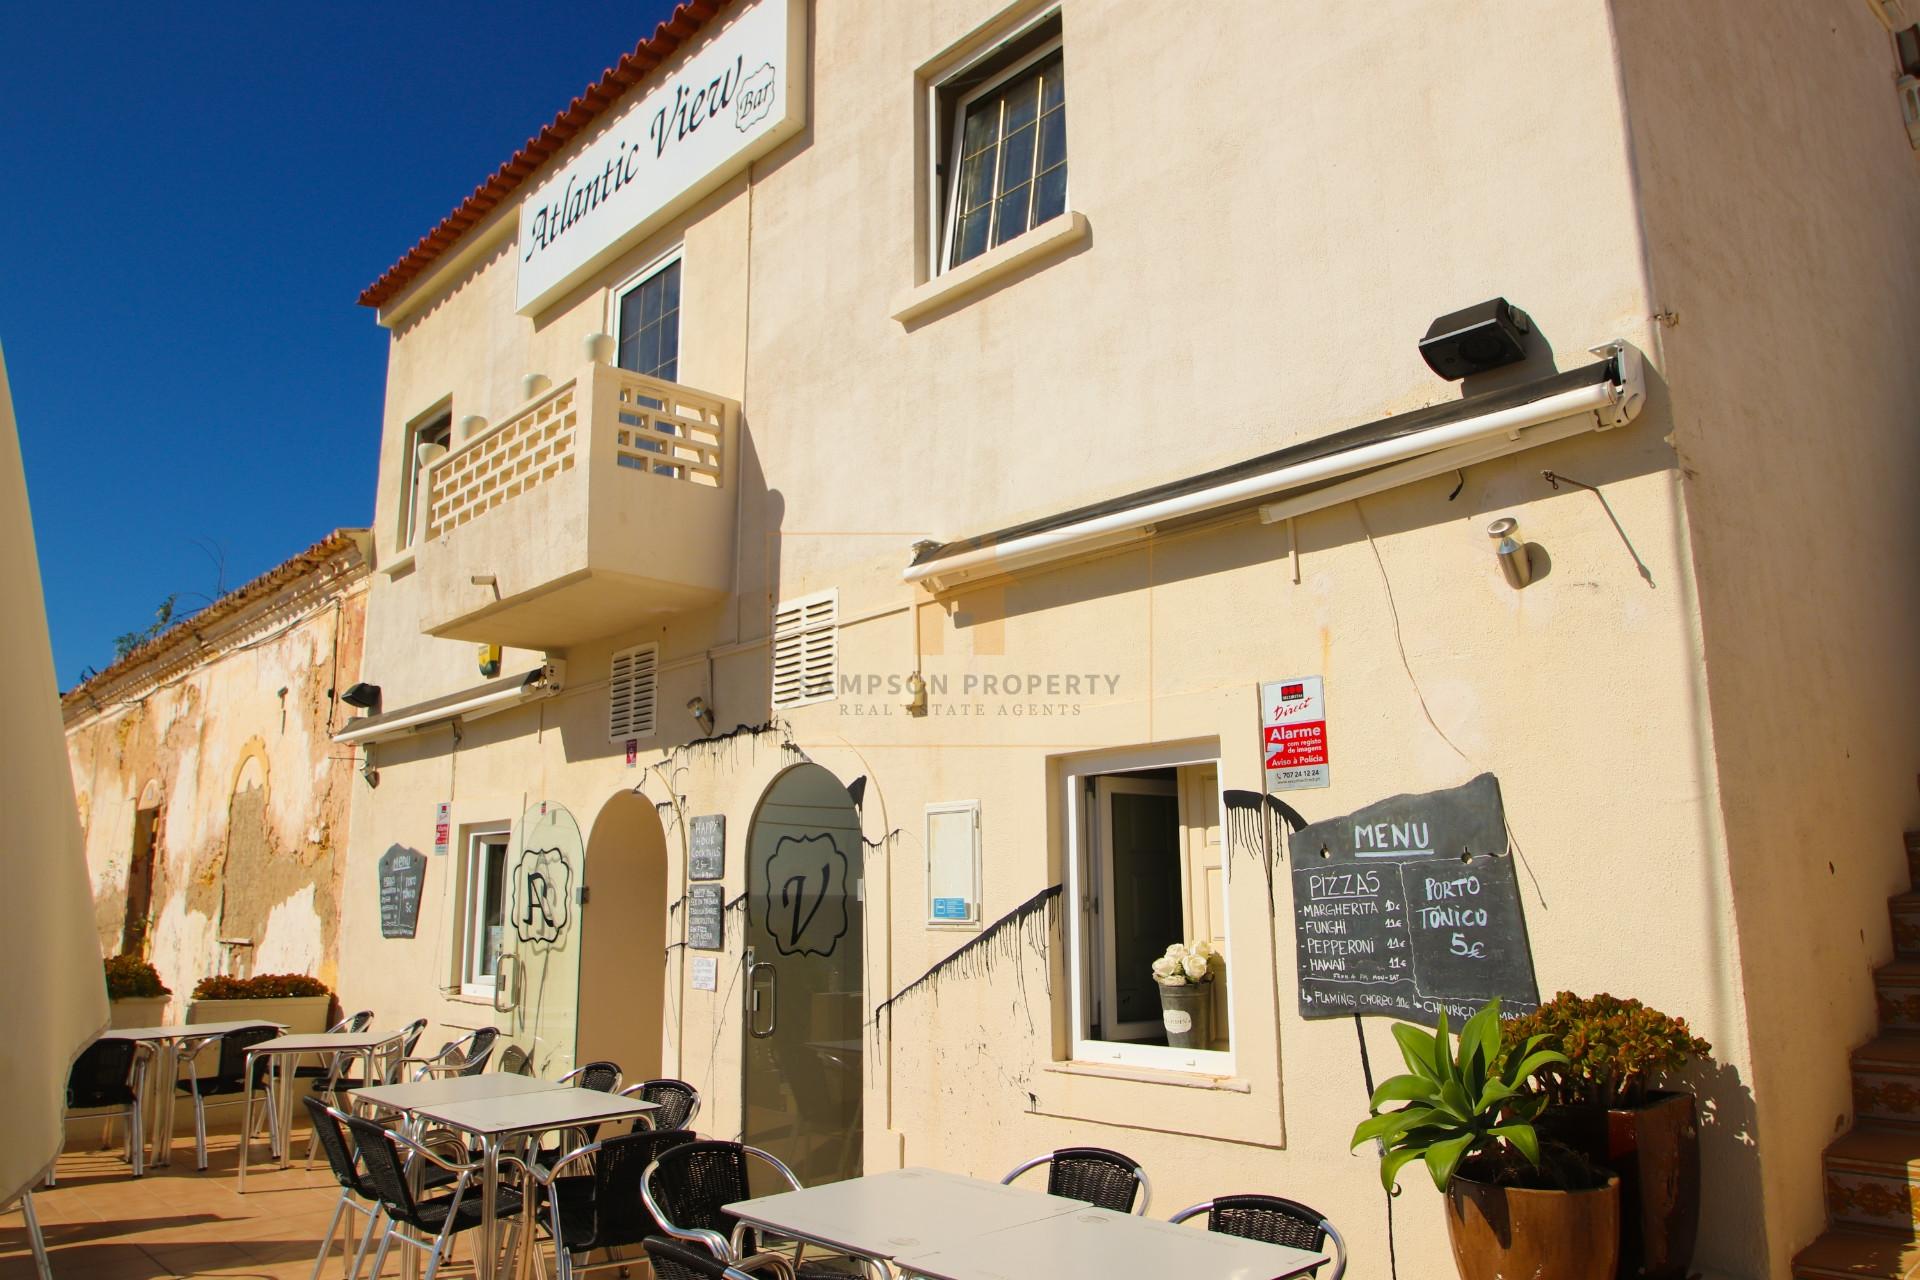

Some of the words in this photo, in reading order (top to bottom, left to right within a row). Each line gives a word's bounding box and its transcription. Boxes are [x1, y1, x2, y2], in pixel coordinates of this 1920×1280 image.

[739, 81, 772, 120] Bar
[525, 141, 640, 263] Atlantic
[650, 53, 743, 160] View
[1273, 696, 1313, 721] Direct
[1270, 726, 1321, 742] Alarme
[1300, 738, 1322, 747] registo
[1296, 745, 1322, 754] imagens
[1271, 758, 1292, 767] Aviso
[1299, 754, 1323, 764] Polícia
[1282, 771, 1294, 779] 707
[1354, 822, 1429, 849] MENU
[1309, 871, 1380, 897] PIZZAS
[1425, 875, 1480, 900] PORTO
[782, 863, 830, 946] V
[1303, 901, 1379, 918] MARGHERITA
[1305, 919, 1347, 934] FUNGHI
[1416, 905, 1488, 930] TONICO
[1307, 938, 1374, 956] PEPPERONI
[1450, 931, 1487, 958] 5€
[1309, 958, 1345, 971] HAWAII
